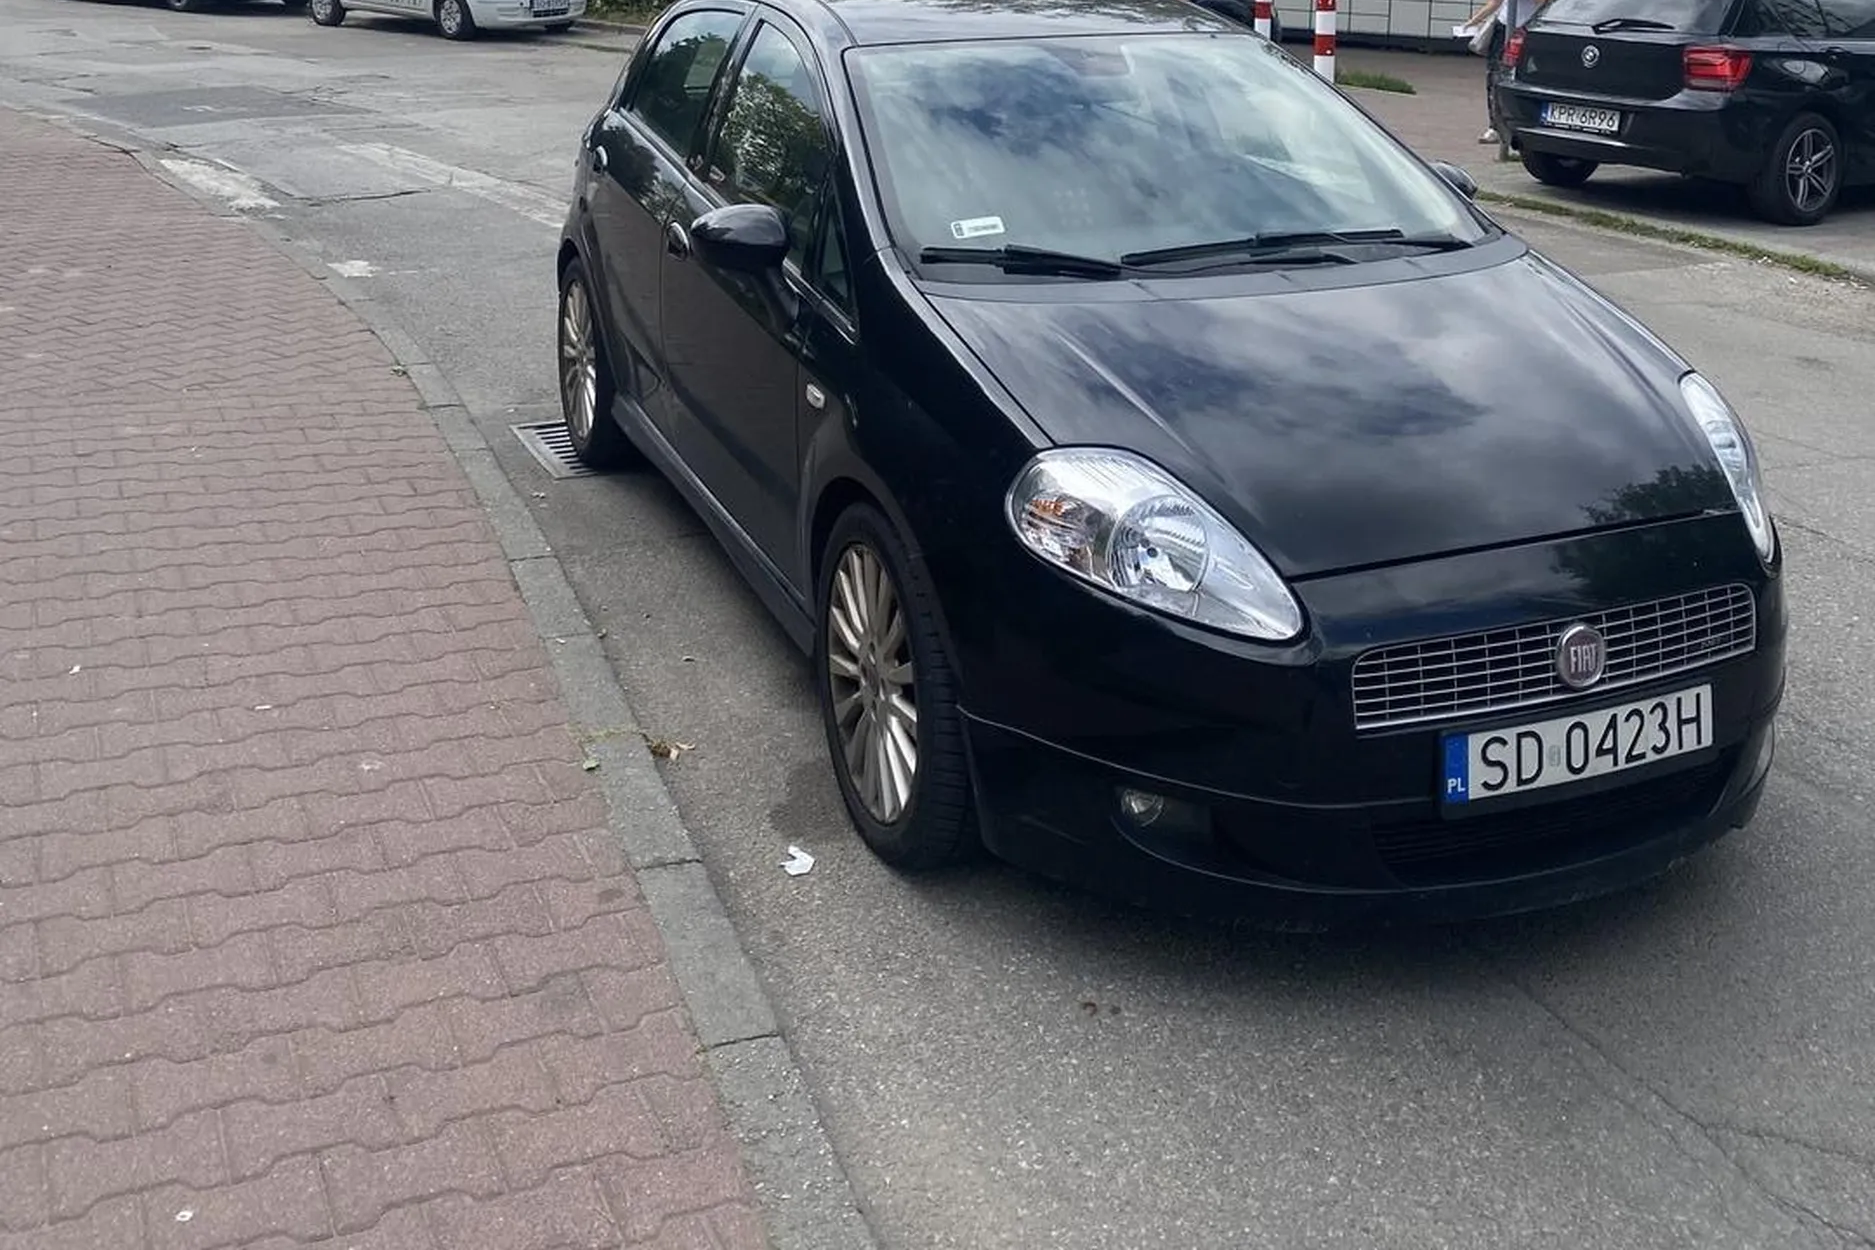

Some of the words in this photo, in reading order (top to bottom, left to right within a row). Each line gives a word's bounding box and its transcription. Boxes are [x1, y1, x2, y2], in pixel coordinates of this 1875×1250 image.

[1580, 108, 1616, 128] 6R96
[1570, 643, 1598, 673] FIAT
[1480, 730, 1544, 791] SD
[1565, 692, 1702, 775] 0423H
[1447, 778, 1466, 793] PL
